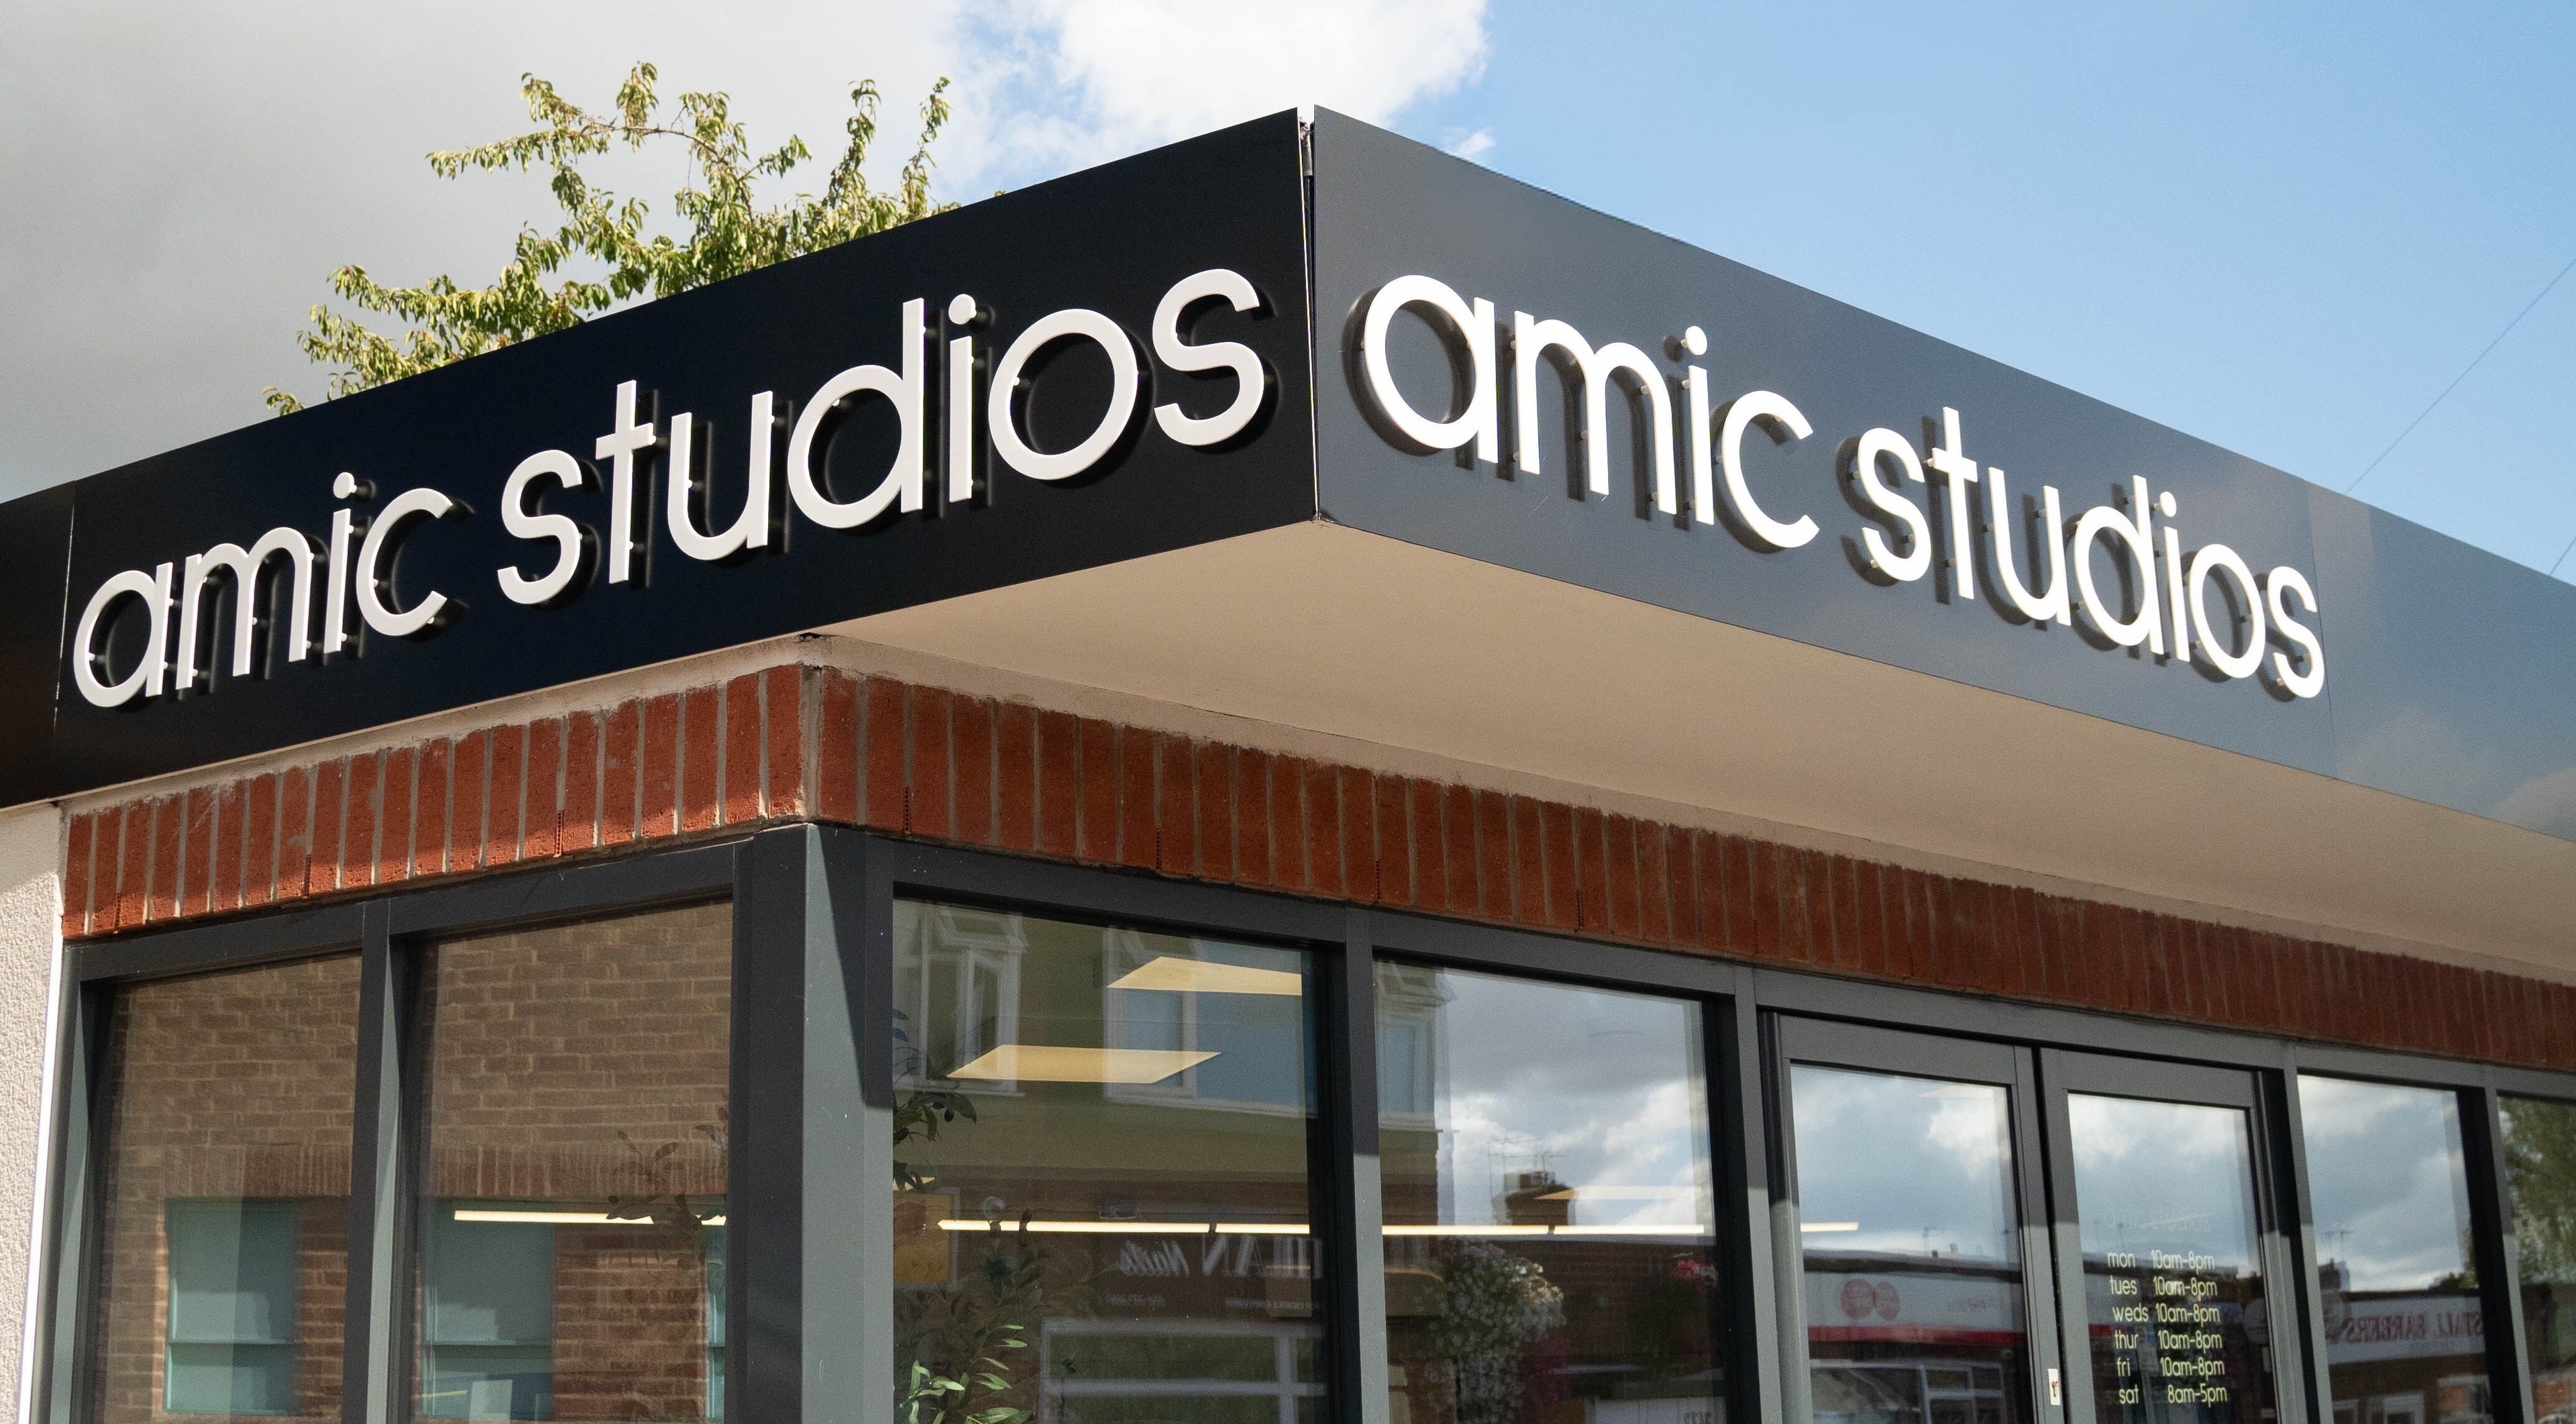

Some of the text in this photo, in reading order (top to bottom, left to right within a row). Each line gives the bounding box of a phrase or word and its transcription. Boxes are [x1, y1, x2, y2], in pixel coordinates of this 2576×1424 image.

[72, 267, 1269, 710] amic studios
[1362, 272, 2330, 702] amic studios
[2107, 1249, 2215, 1275] mon 10am-8pm
[2110, 1275, 2218, 1301] tues 10am-8pm
[2112, 1303, 2220, 1327] weds 10am-8pm
[2114, 1329, 2222, 1354] thur 10am-8pm
[2116, 1357, 2225, 1380] fri 10am-8pm
[2118, 1383, 2228, 1408] sat 8am-5pm
